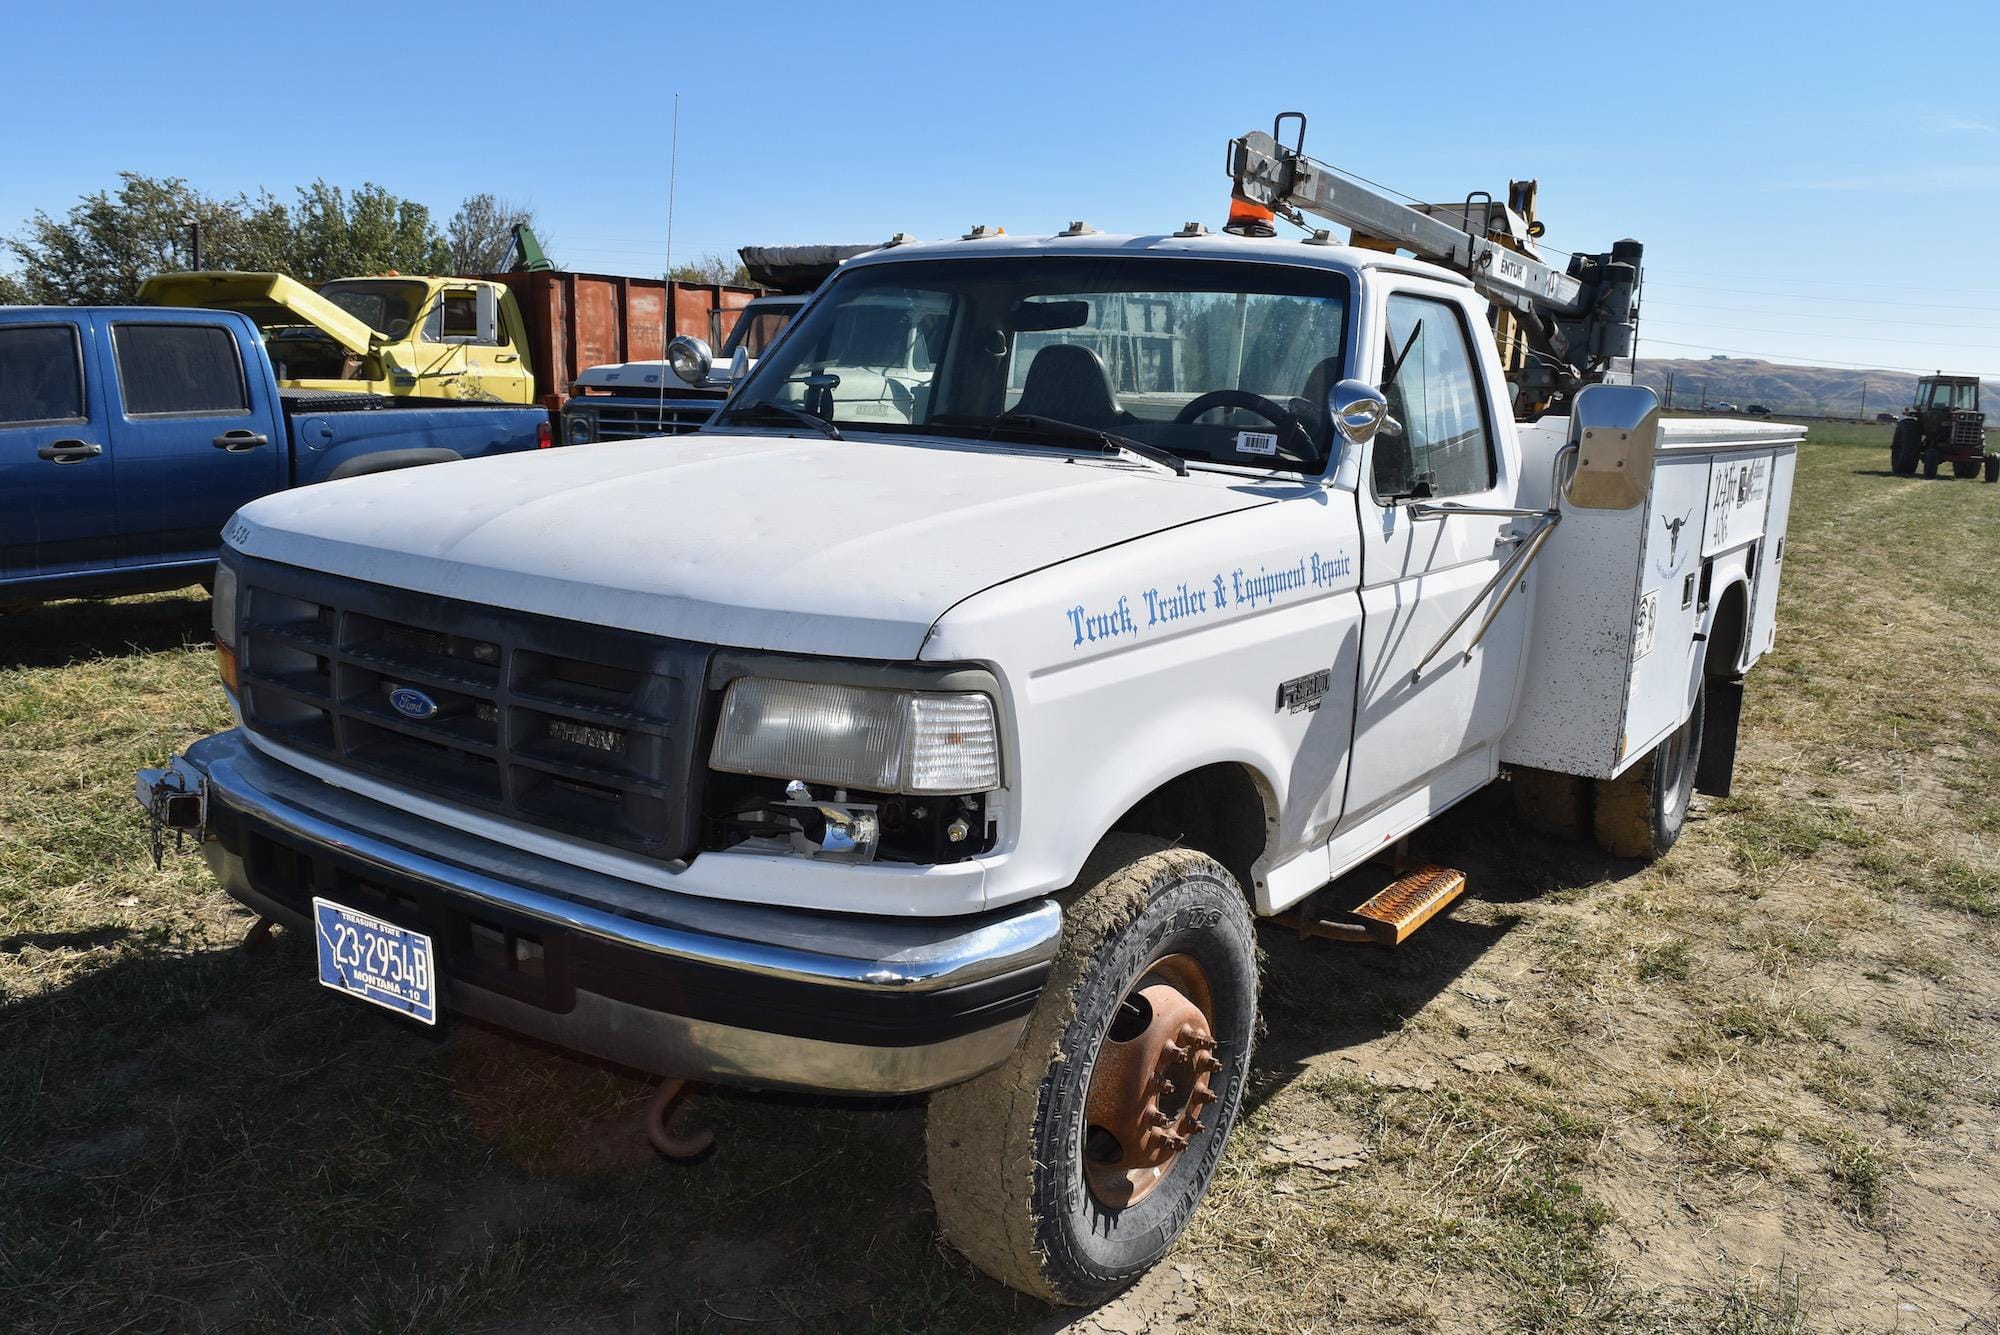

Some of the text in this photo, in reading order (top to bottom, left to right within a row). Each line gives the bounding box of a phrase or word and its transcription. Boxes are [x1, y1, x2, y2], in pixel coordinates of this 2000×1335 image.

[1066, 549, 1351, 650] Truck, Trailer & Equipment Repair
[399, 693, 423, 713] Ford
[341, 912, 401, 938] TREASURE STATE
[353, 969, 401, 995] MONTANA
[1159, 1050, 1246, 1243] YOKOHAMA
